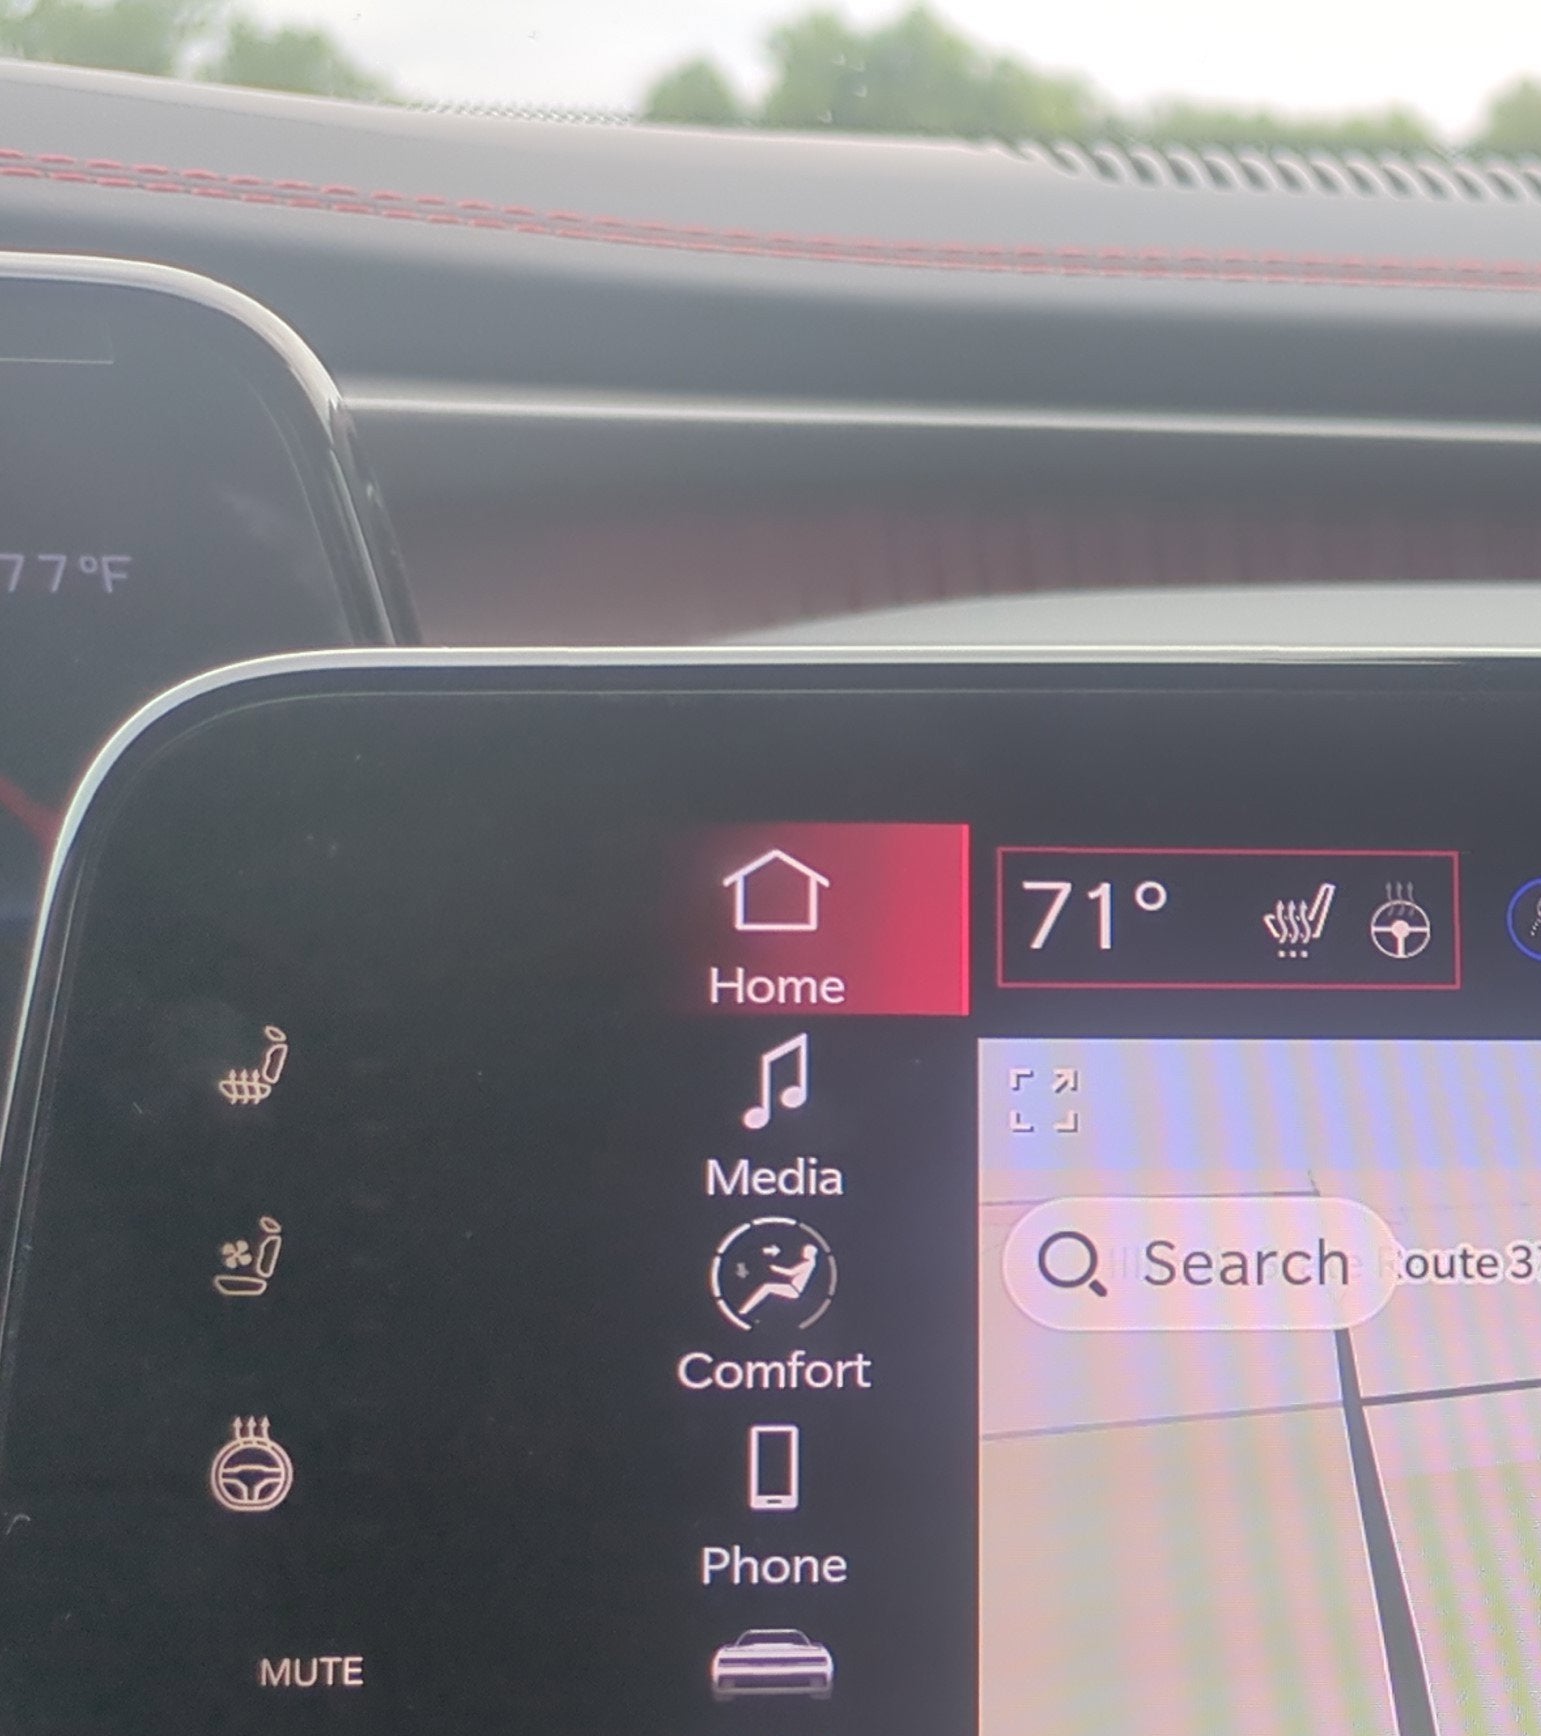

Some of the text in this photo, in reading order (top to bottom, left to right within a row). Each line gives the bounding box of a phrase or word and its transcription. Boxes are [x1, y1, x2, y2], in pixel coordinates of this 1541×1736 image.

[1020, 880, 1168, 951] 71°
[709, 966, 846, 1005] Home
[704, 1158, 844, 1196] Media
[1143, 1238, 1350, 1287] Search
[677, 1351, 873, 1390] Comfort
[701, 1546, 848, 1586] Phone
[259, 1656, 365, 1688] MUTE
